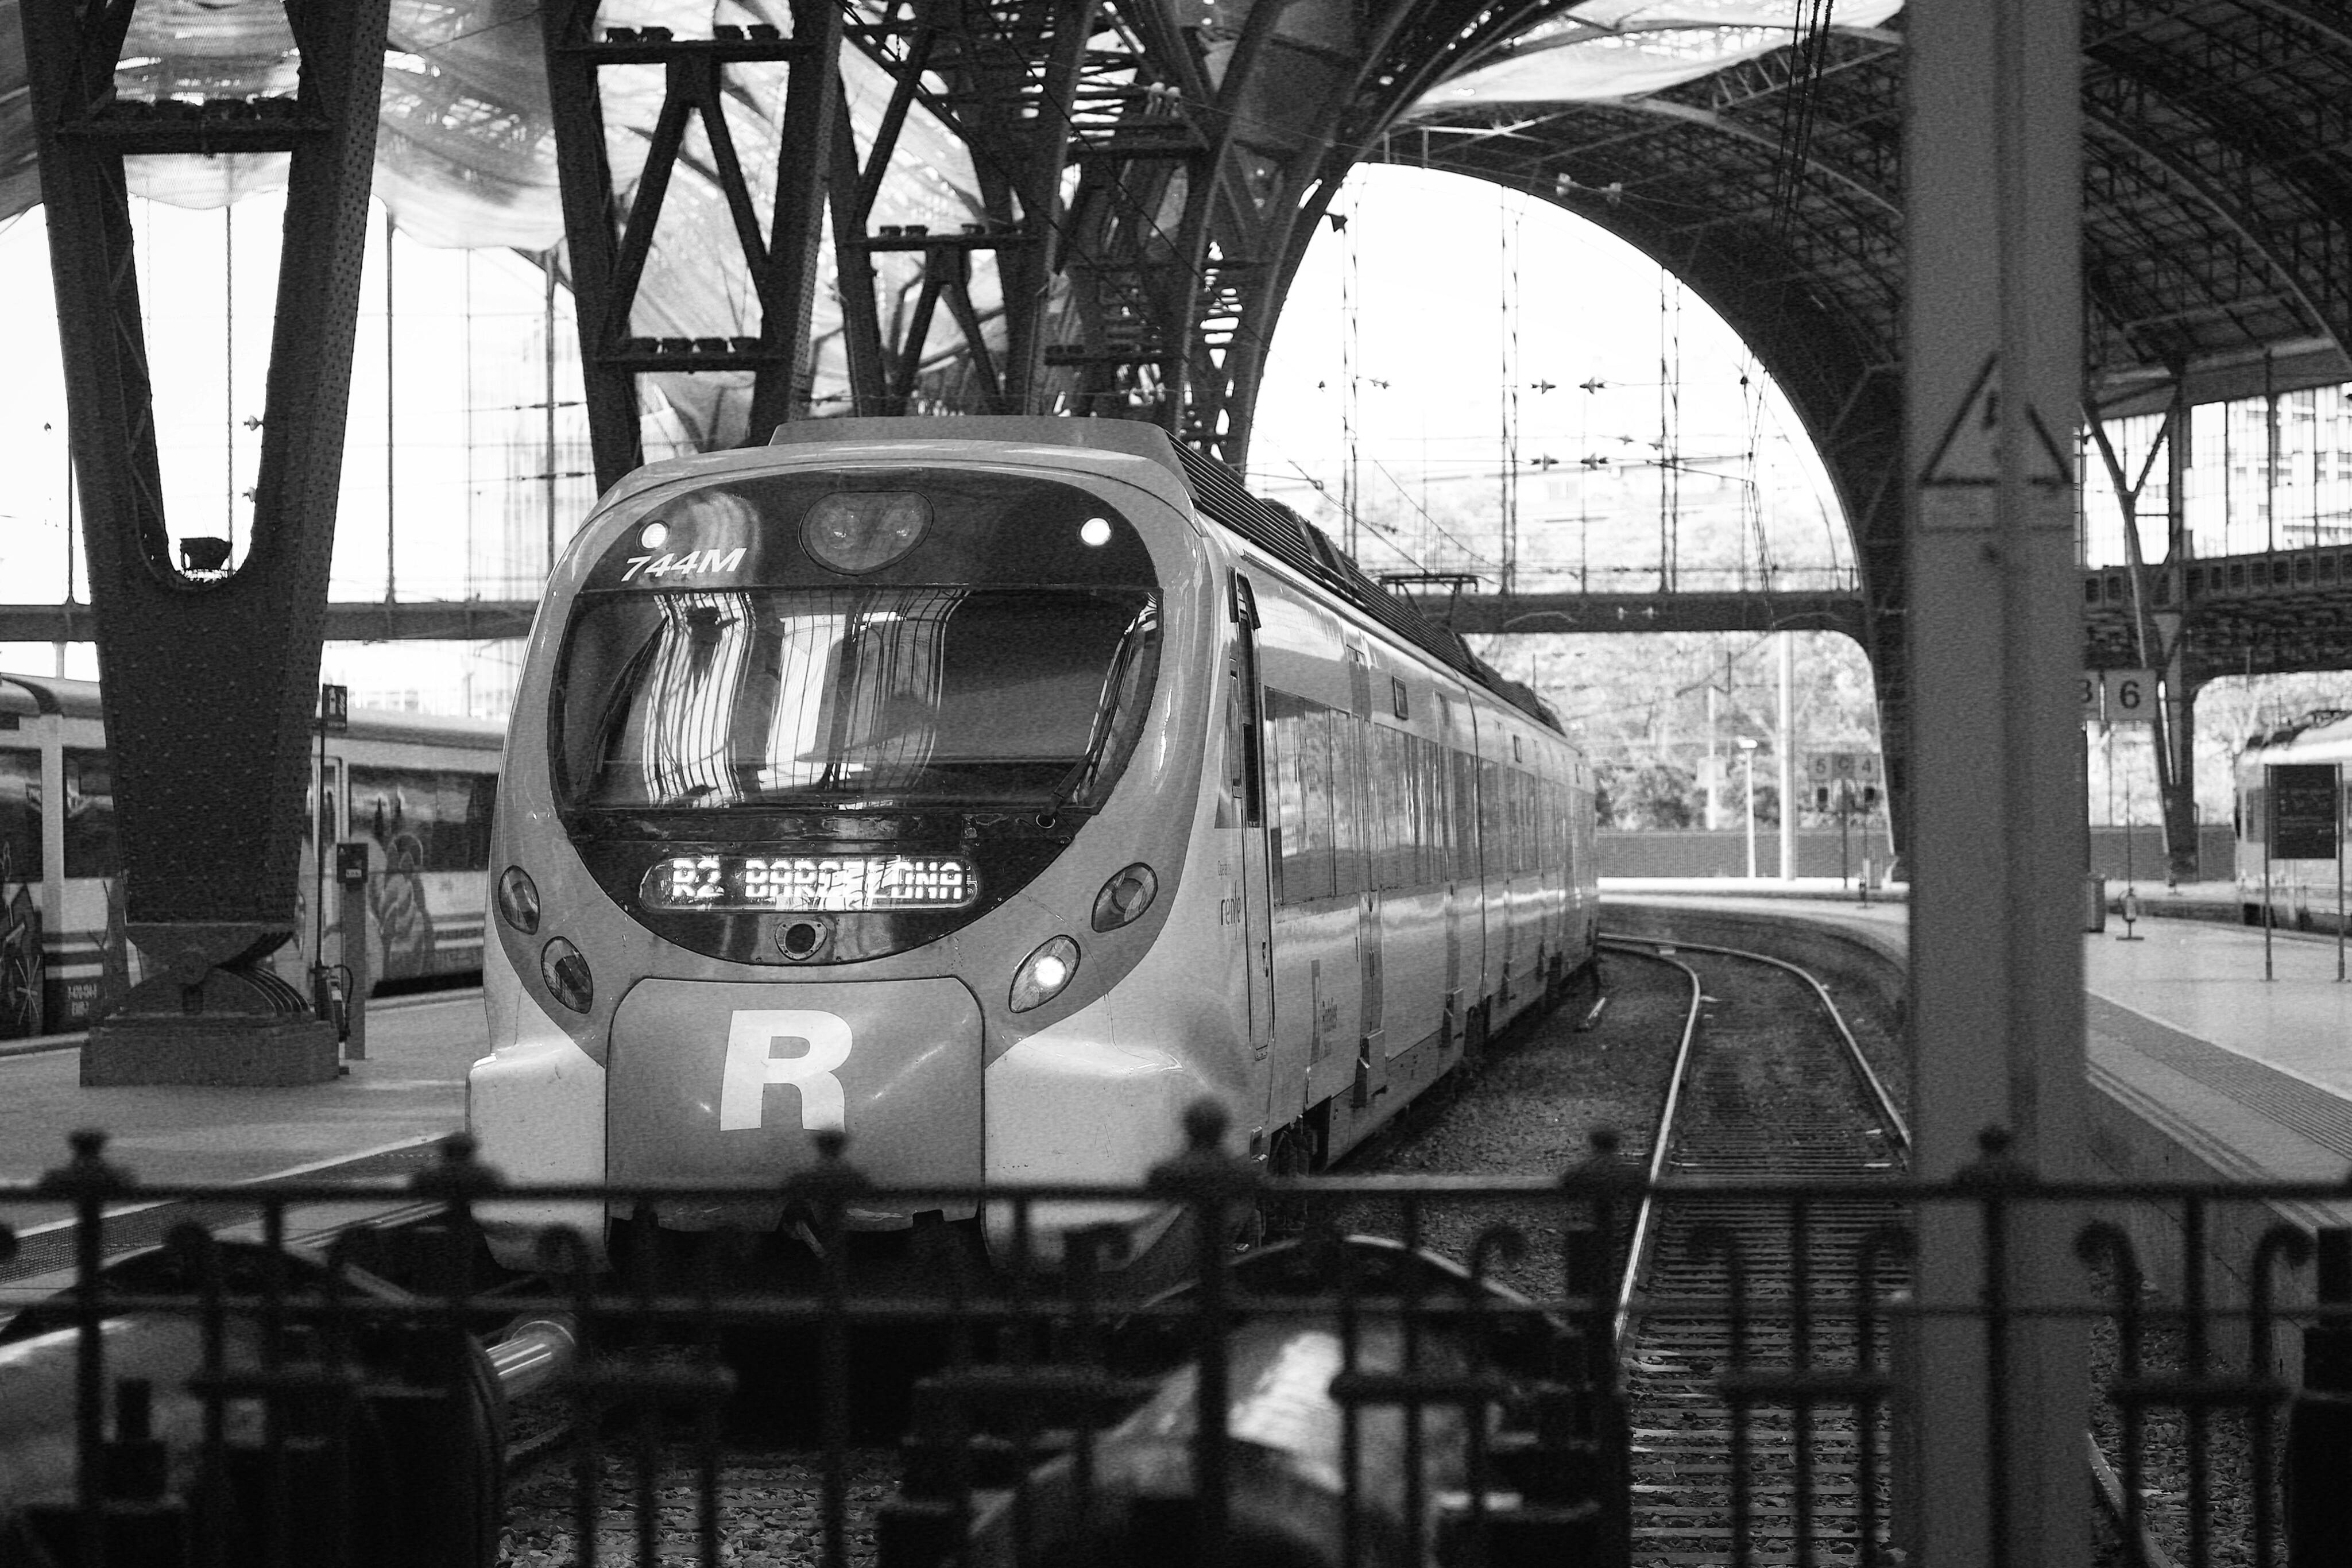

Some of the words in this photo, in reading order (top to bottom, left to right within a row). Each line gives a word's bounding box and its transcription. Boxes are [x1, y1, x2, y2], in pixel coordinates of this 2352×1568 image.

[621, 547, 748, 582] 744M
[2119, 680, 2141, 709] 6
[1862, 757, 1871, 773] 4
[672, 860, 722, 897] R2
[720, 1009, 853, 1132] R
